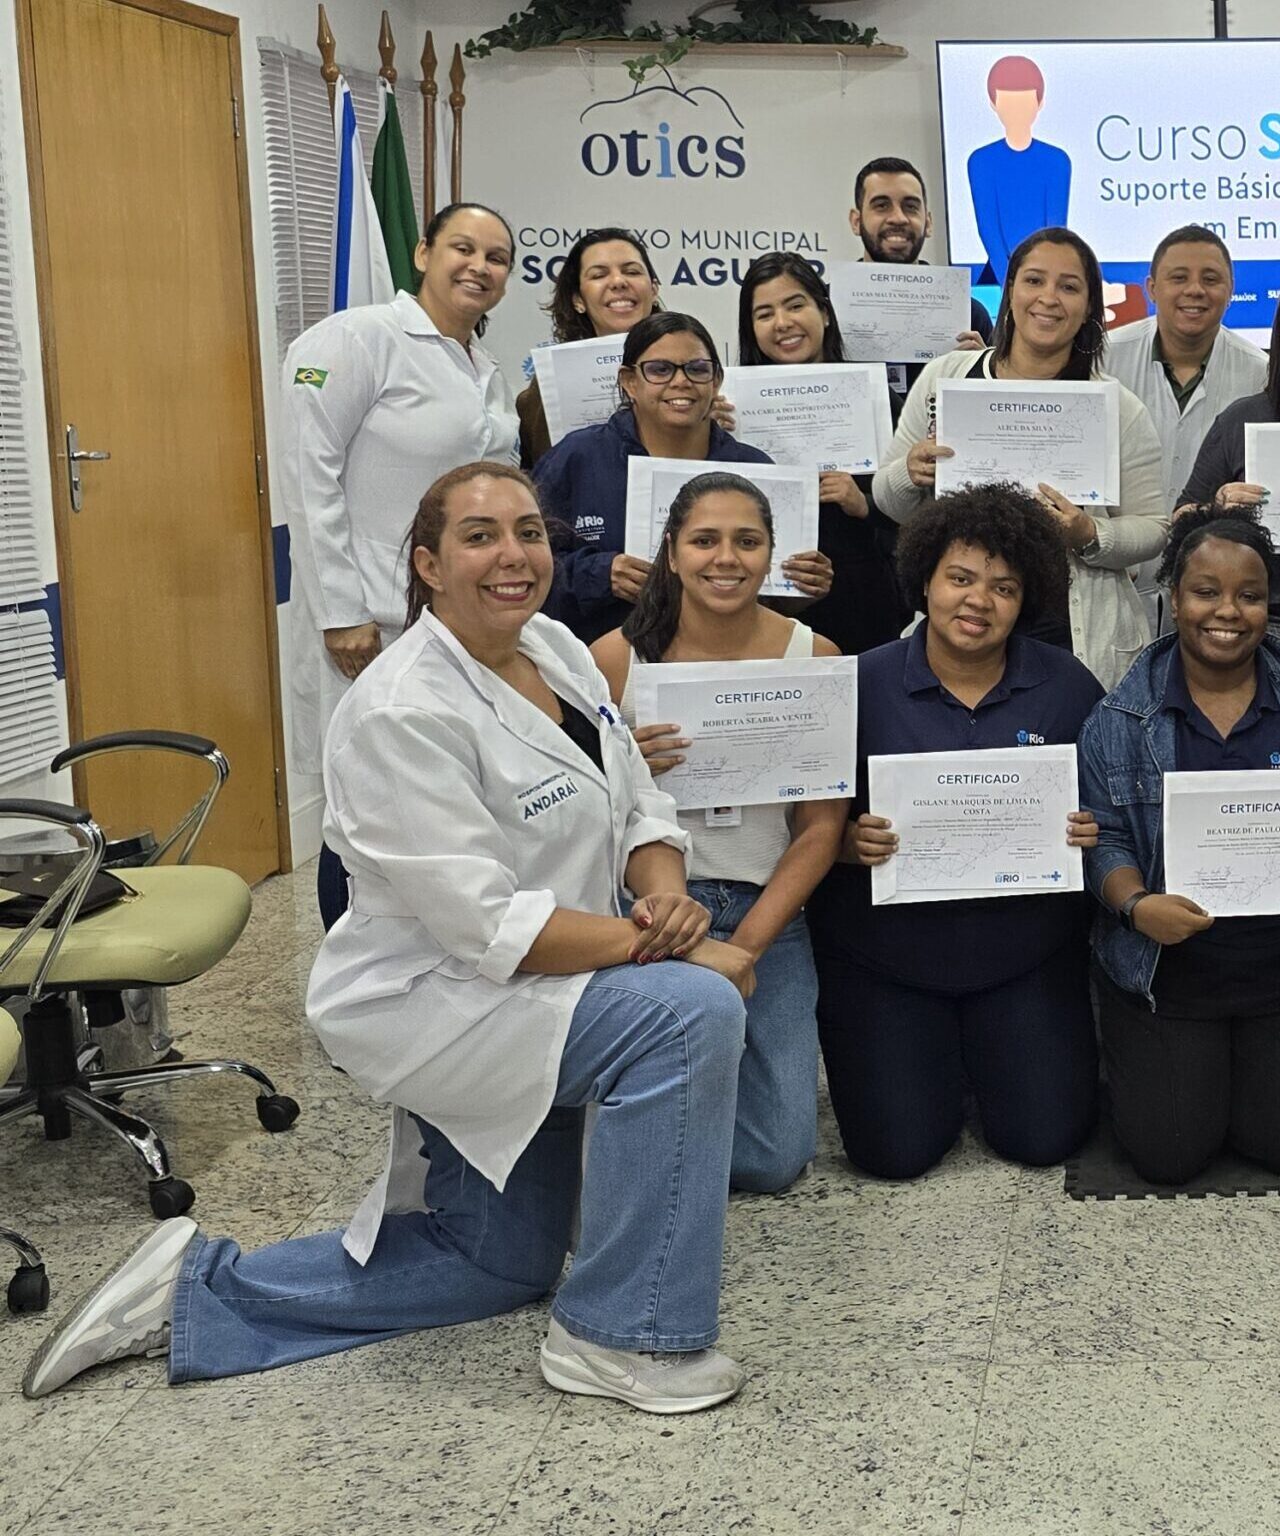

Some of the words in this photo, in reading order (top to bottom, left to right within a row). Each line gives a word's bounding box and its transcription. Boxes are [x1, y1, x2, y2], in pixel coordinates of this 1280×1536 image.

[1096, 114, 1246, 161] Curso
[581, 122, 745, 178] otics
[1100, 177, 1207, 206] Suporte
[681, 230, 828, 251] MUNICIPAL
[870, 273, 933, 284] CERTIFICADO
[760, 384, 830, 398] CERTIFICADO
[990, 402, 1062, 414] CERTIFICADO
[715, 689, 803, 705] CERTIFICADO
[702, 718, 744, 728] ROBERTA
[746, 715, 780, 725] SEABRA
[937, 773, 1020, 785] CERTIFICADO
[787, 787, 805, 797] RIO
[524, 777, 579, 820] ANDARAÍ
[913, 799, 950, 808] GISLANE
[951, 799, 992, 808] MARQUES
[993, 799, 1004, 807] DE
[963, 808, 991, 816] COSTA
[1206, 827, 1242, 836] BEATRIZ
[1002, 874, 1019, 883] RIO
